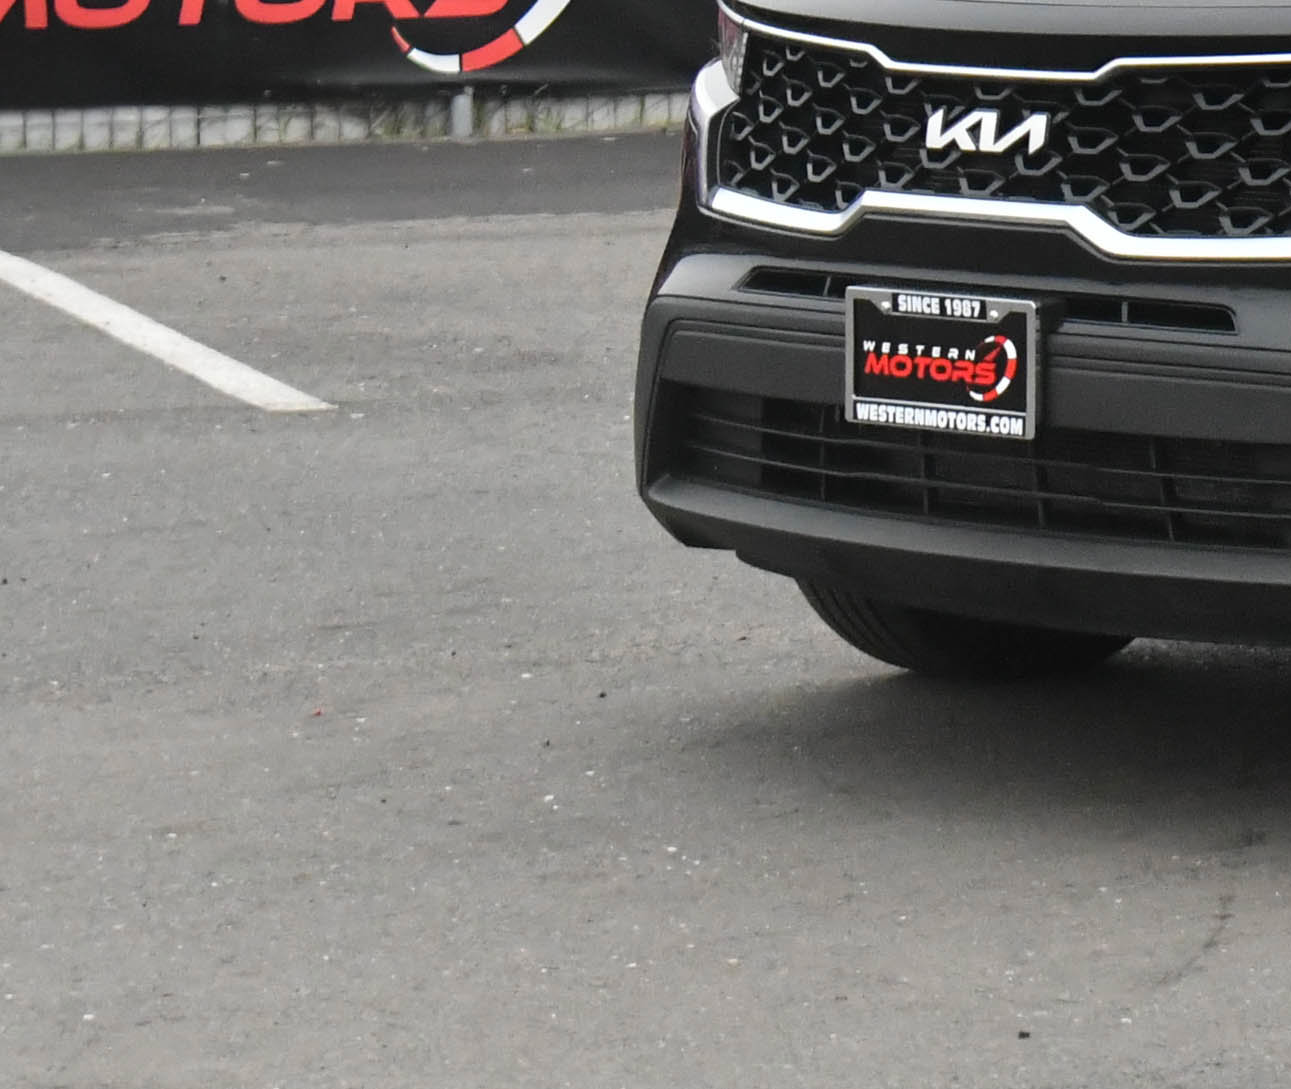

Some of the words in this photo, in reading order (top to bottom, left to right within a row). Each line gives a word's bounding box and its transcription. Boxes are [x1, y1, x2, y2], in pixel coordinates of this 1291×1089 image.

[925, 108, 1048, 155] KIA
[897, 294, 941, 314] SINCE
[944, 298, 982, 318] 1987
[862, 340, 976, 361] WESTERN
[864, 351, 998, 386] MOTORS
[855, 402, 1025, 437] WESTERNMOTORS.COM
